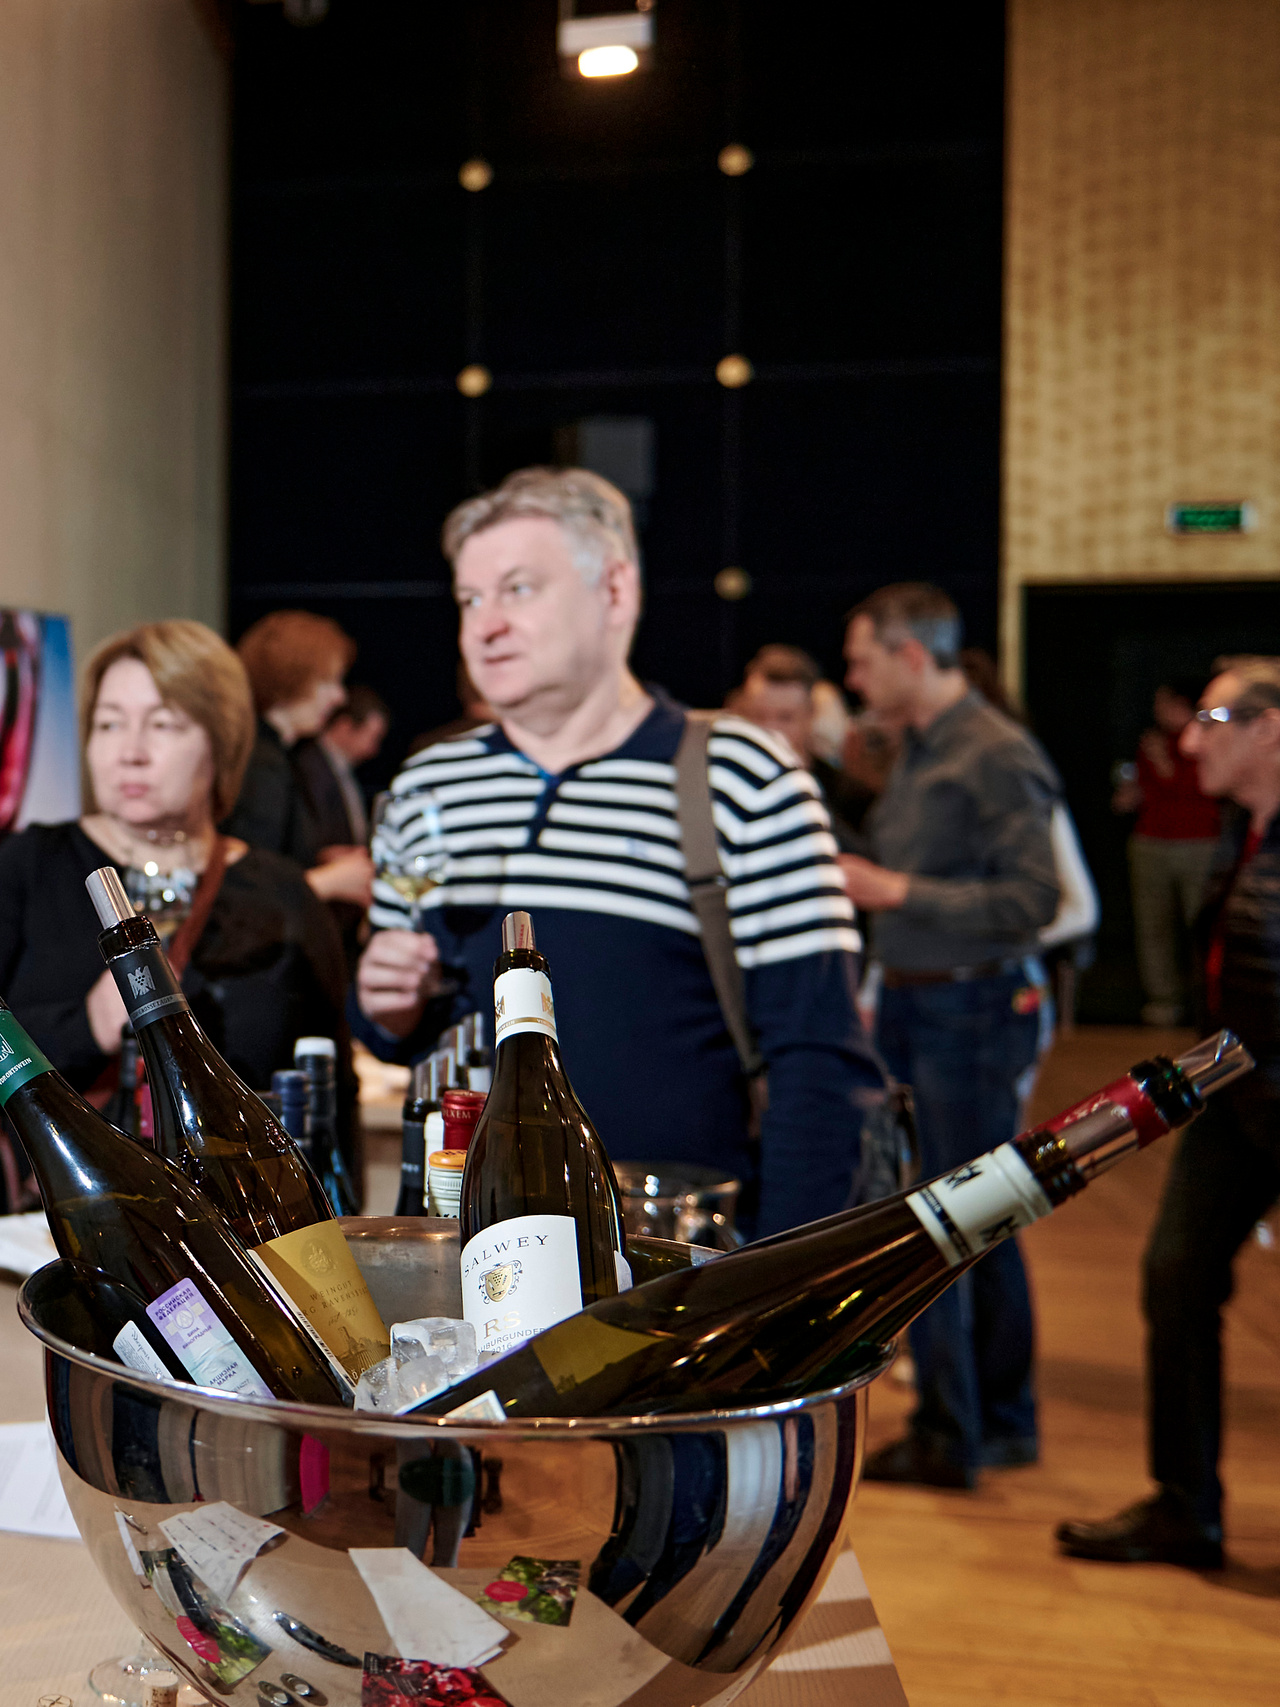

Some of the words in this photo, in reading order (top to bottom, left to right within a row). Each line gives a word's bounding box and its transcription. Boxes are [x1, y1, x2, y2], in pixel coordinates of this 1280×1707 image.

[464, 1234, 549, 1278] SALWEY
[155, 1287, 191, 1317] РОССИЙСКАЯ
[309, 1279, 352, 1301] WEINGUT
[158, 1292, 195, 1321] ФЕДЕРАЦИЯ
[302, 1305, 317, 1317] RG
[483, 1310, 522, 1340] RS
[477, 1327, 547, 1355] AUBURGUNDER
[491, 1342, 514, 1356] 2016
[208, 1361, 239, 1386] АКЦИЗНАЯ
[216, 1370, 238, 1387] МАРКА
